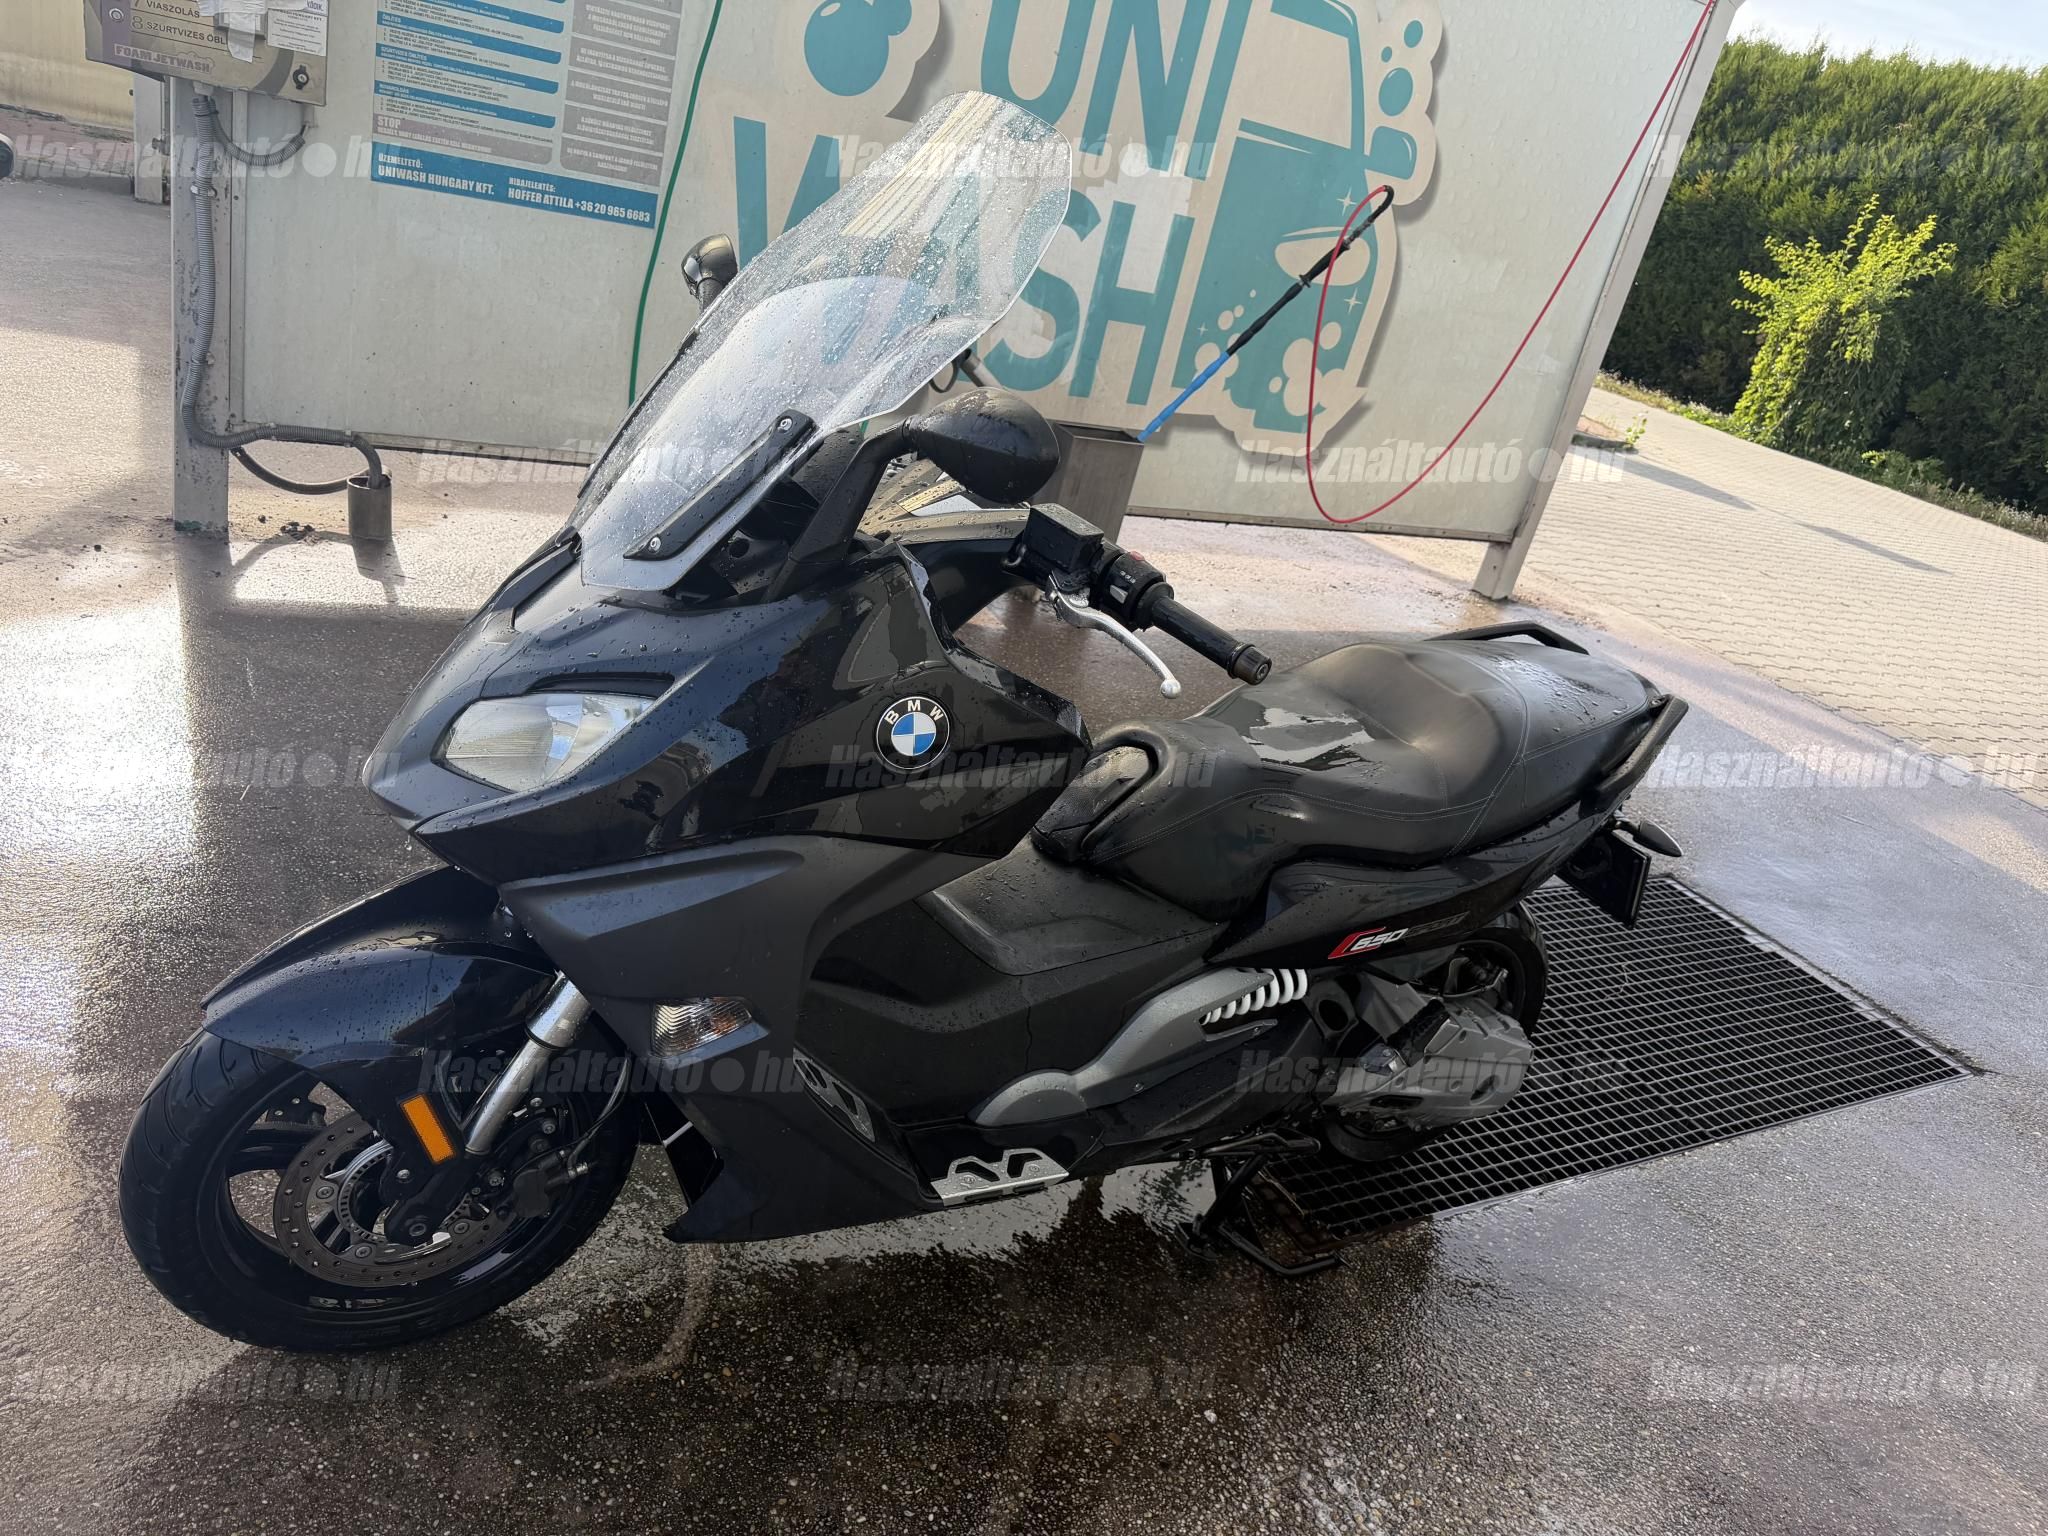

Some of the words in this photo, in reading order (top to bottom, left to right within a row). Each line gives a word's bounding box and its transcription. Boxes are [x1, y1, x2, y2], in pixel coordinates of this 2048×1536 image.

[131, 15, 144, 30] 8
[378, 115, 401, 130] STOP
[378, 164, 426, 183] UNIWASH
[427, 173, 475, 192] HUNGARY
[475, 182, 495, 196] KFT.
[508, 187, 542, 204] HOFFER
[542, 193, 574, 209] ATTILA
[593, 203, 606, 215] 20
[884, 699, 945, 726] BMW
